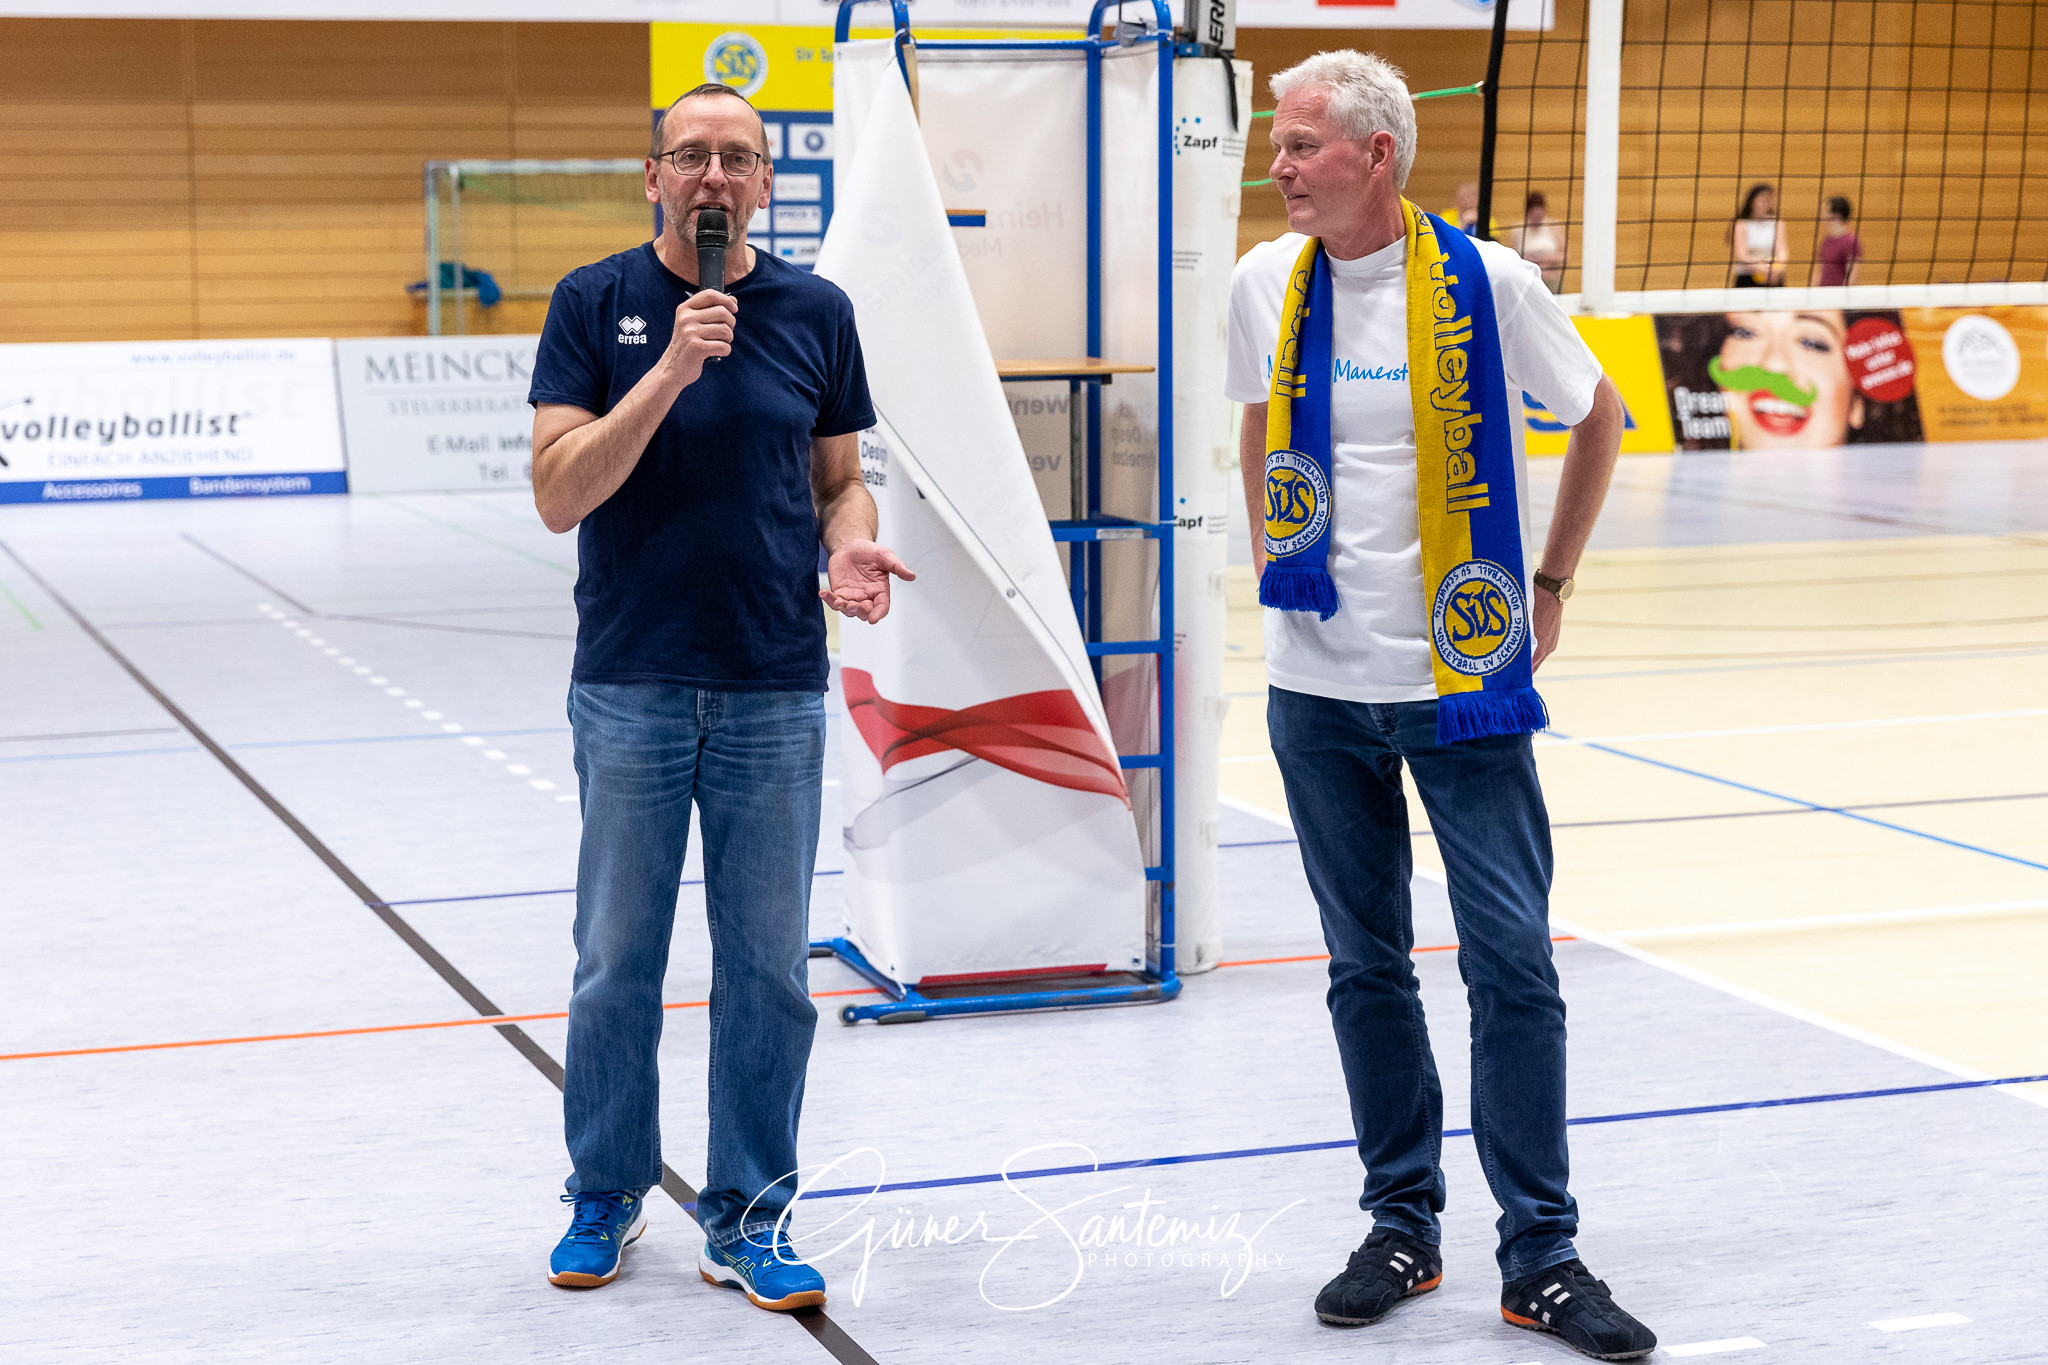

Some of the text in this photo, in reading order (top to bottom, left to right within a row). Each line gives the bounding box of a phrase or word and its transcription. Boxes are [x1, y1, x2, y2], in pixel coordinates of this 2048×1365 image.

[1183, 135, 1218, 150] Zapf
[618, 333, 648, 345] errea
[364, 349, 537, 384] MEINCK
[0, 410, 241, 445] volleyballist
[1678, 411, 1731, 440] Team
[42, 475, 312, 499] Accessoires Bandensystem
